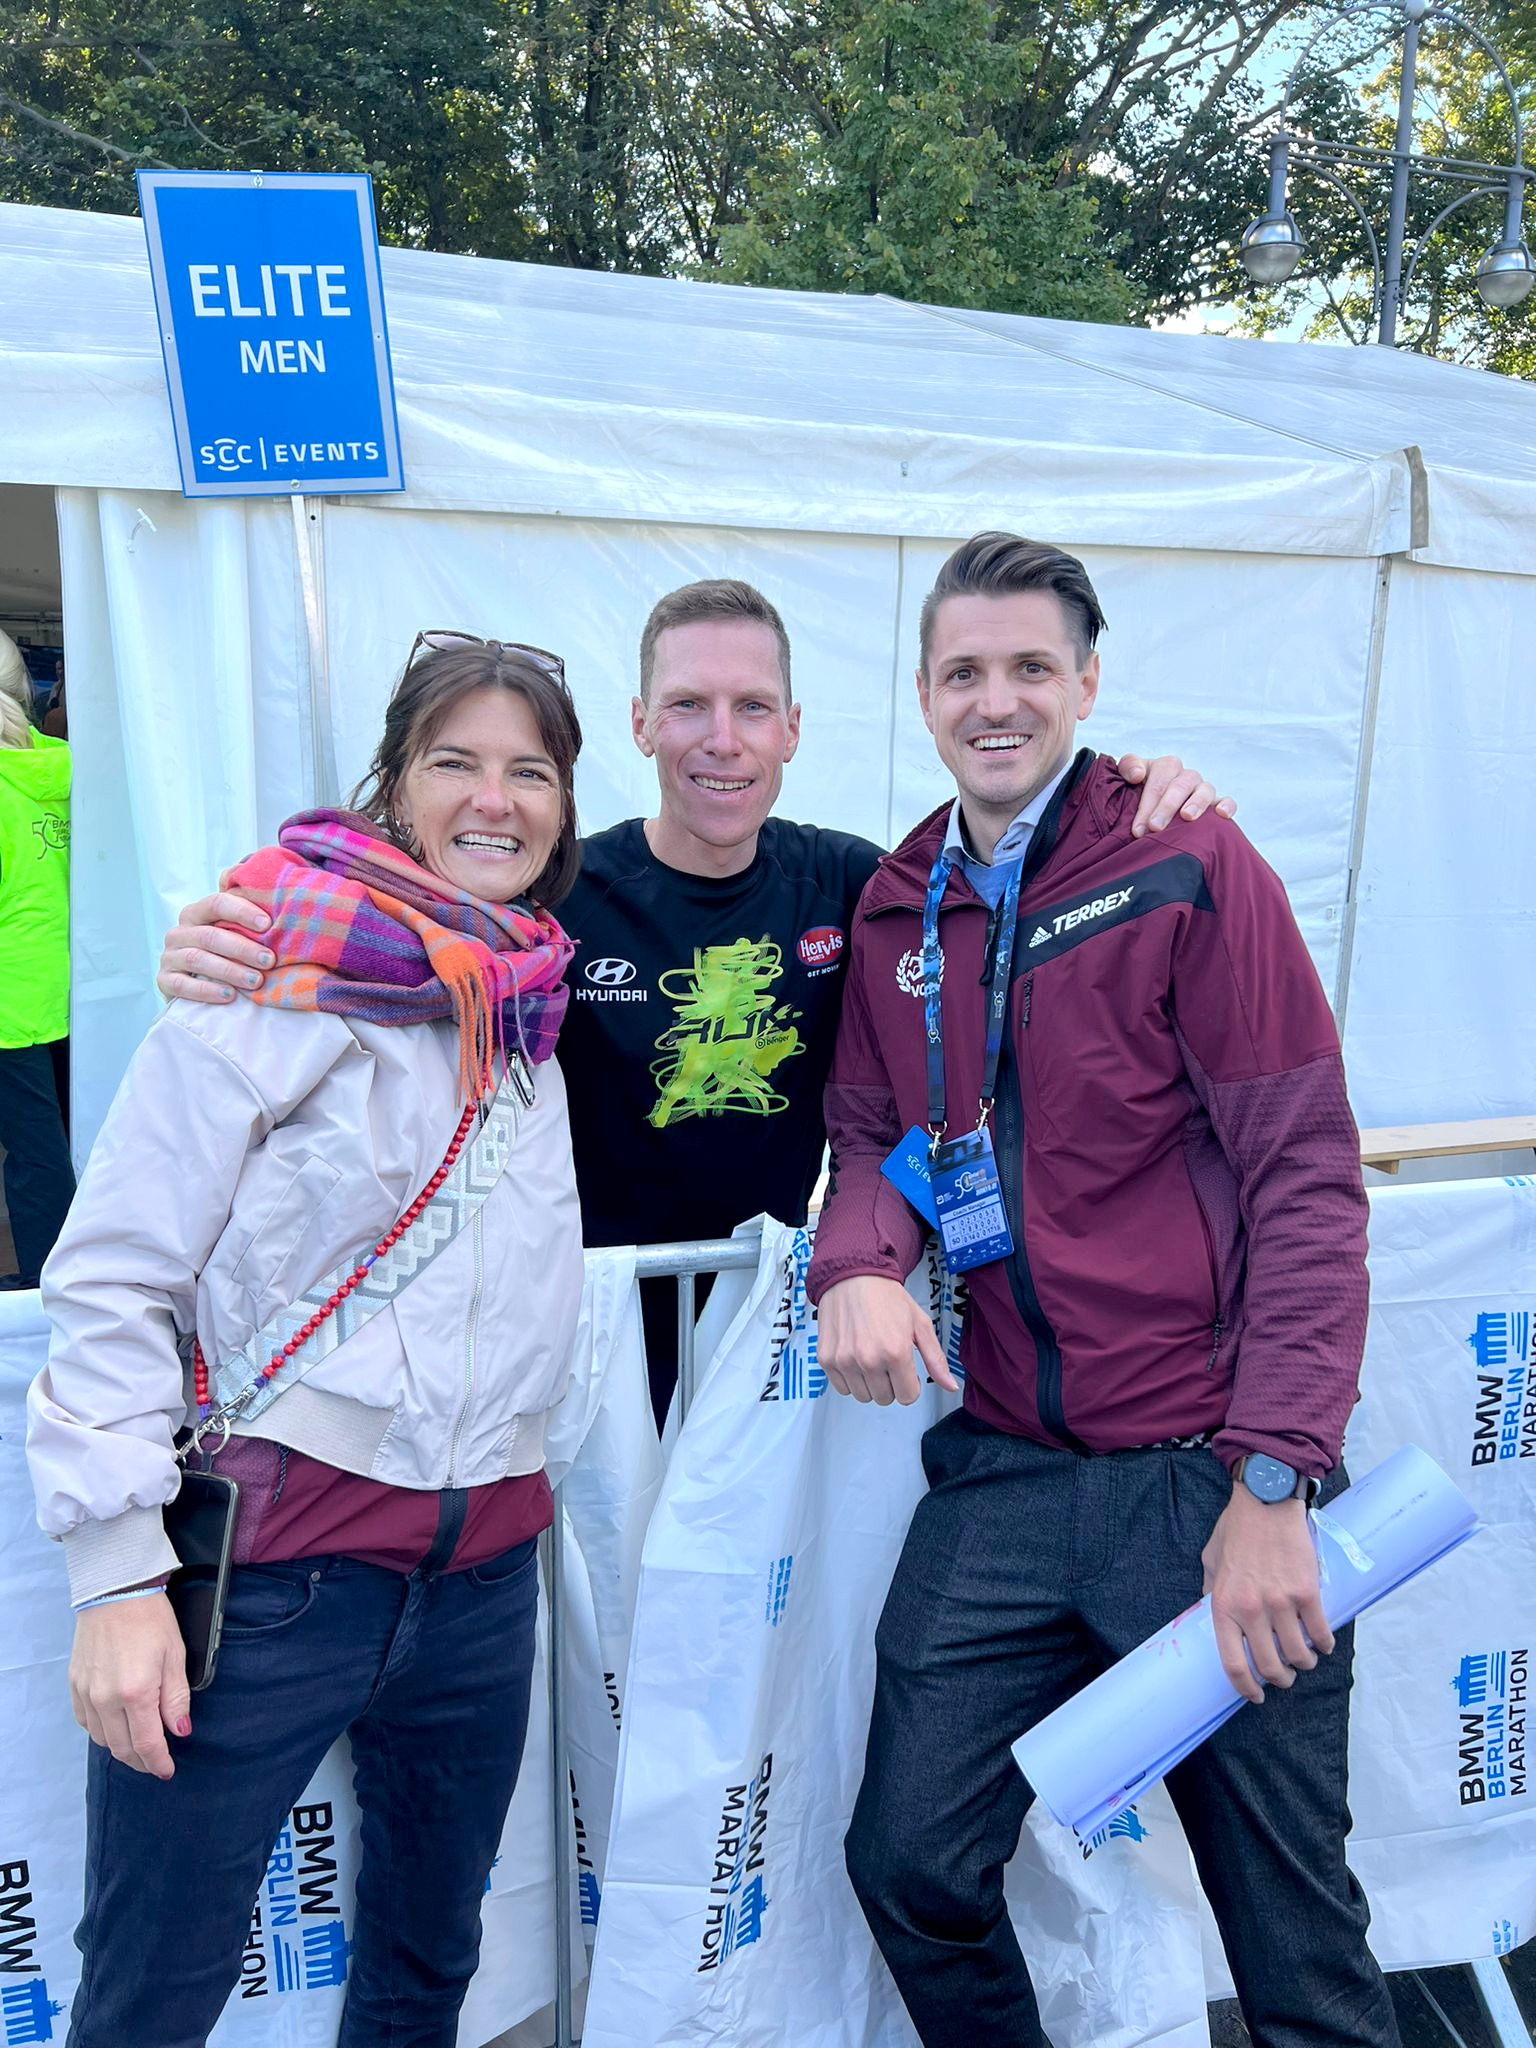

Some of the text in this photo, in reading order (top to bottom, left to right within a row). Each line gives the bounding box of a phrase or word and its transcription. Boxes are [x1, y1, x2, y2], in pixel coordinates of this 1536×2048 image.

[188, 265, 351, 317] ELITE
[240, 340, 326, 374] MEN
[201, 440, 379, 468] SCC EVENTS
[800, 934, 844, 958] Hervis
[1053, 886, 1135, 936] TERREX
[576, 988, 648, 1002] HYUNDAI
[1471, 1374, 1504, 1467] BMW
[1499, 1367, 1526, 1460] BERLIN
[1458, 1714, 1486, 1806] BMW
[1486, 1703, 1506, 1799] BERLIN
[1508, 1648, 1529, 1796] MARATHON
[293, 1801, 341, 1914] BMW
[0, 1859, 41, 1973] BMW
